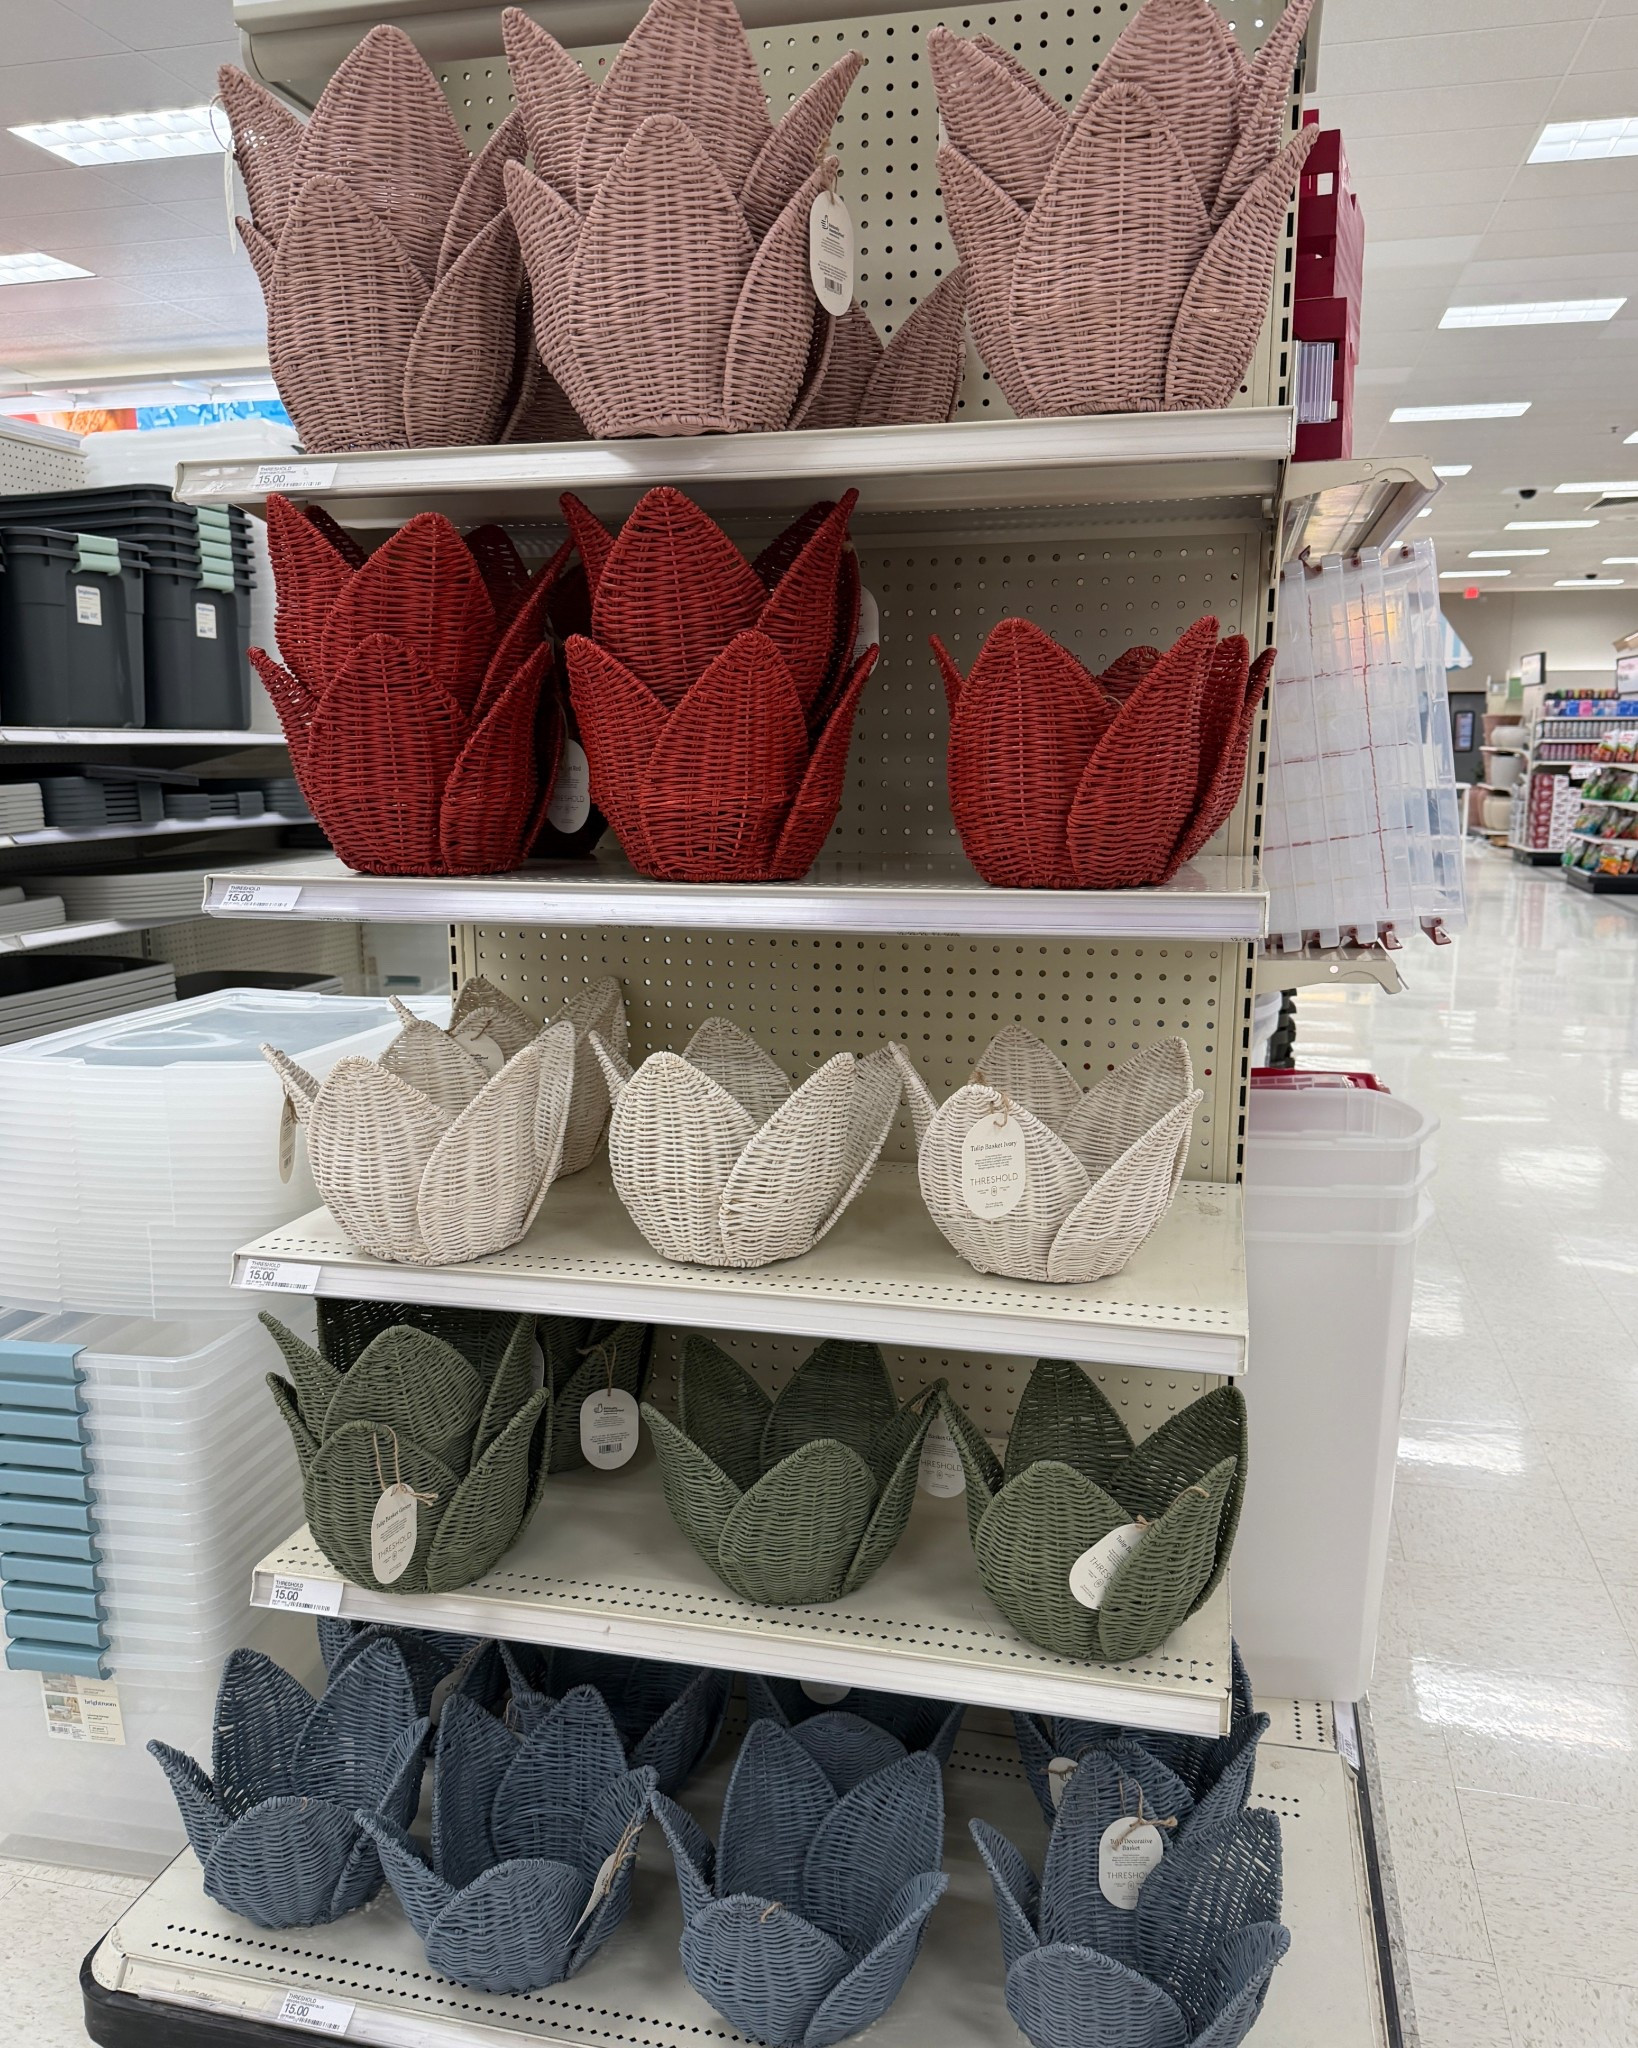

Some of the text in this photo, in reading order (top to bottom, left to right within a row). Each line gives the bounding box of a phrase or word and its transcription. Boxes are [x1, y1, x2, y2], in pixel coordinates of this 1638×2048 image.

[259, 475, 286, 484] 15.00
[227, 893, 254, 902] 15.00
[971, 1140, 1017, 1152] Tulip Basket Ivory
[970, 1172, 1018, 1187] THRESHOLD
[249, 1270, 275, 1281] 15.00
[920, 1458, 962, 1472] HRESHOLD
[377, 1531, 412, 1560] THRESHOLD
[1116, 1534, 1127, 1548] Tulip
[274, 1588, 299, 1601] 15.00
[1107, 1871, 1147, 1880] THRESHO
[288, 1992, 317, 2004] THRESHOLD
[284, 2002, 310, 2017] 15.00
